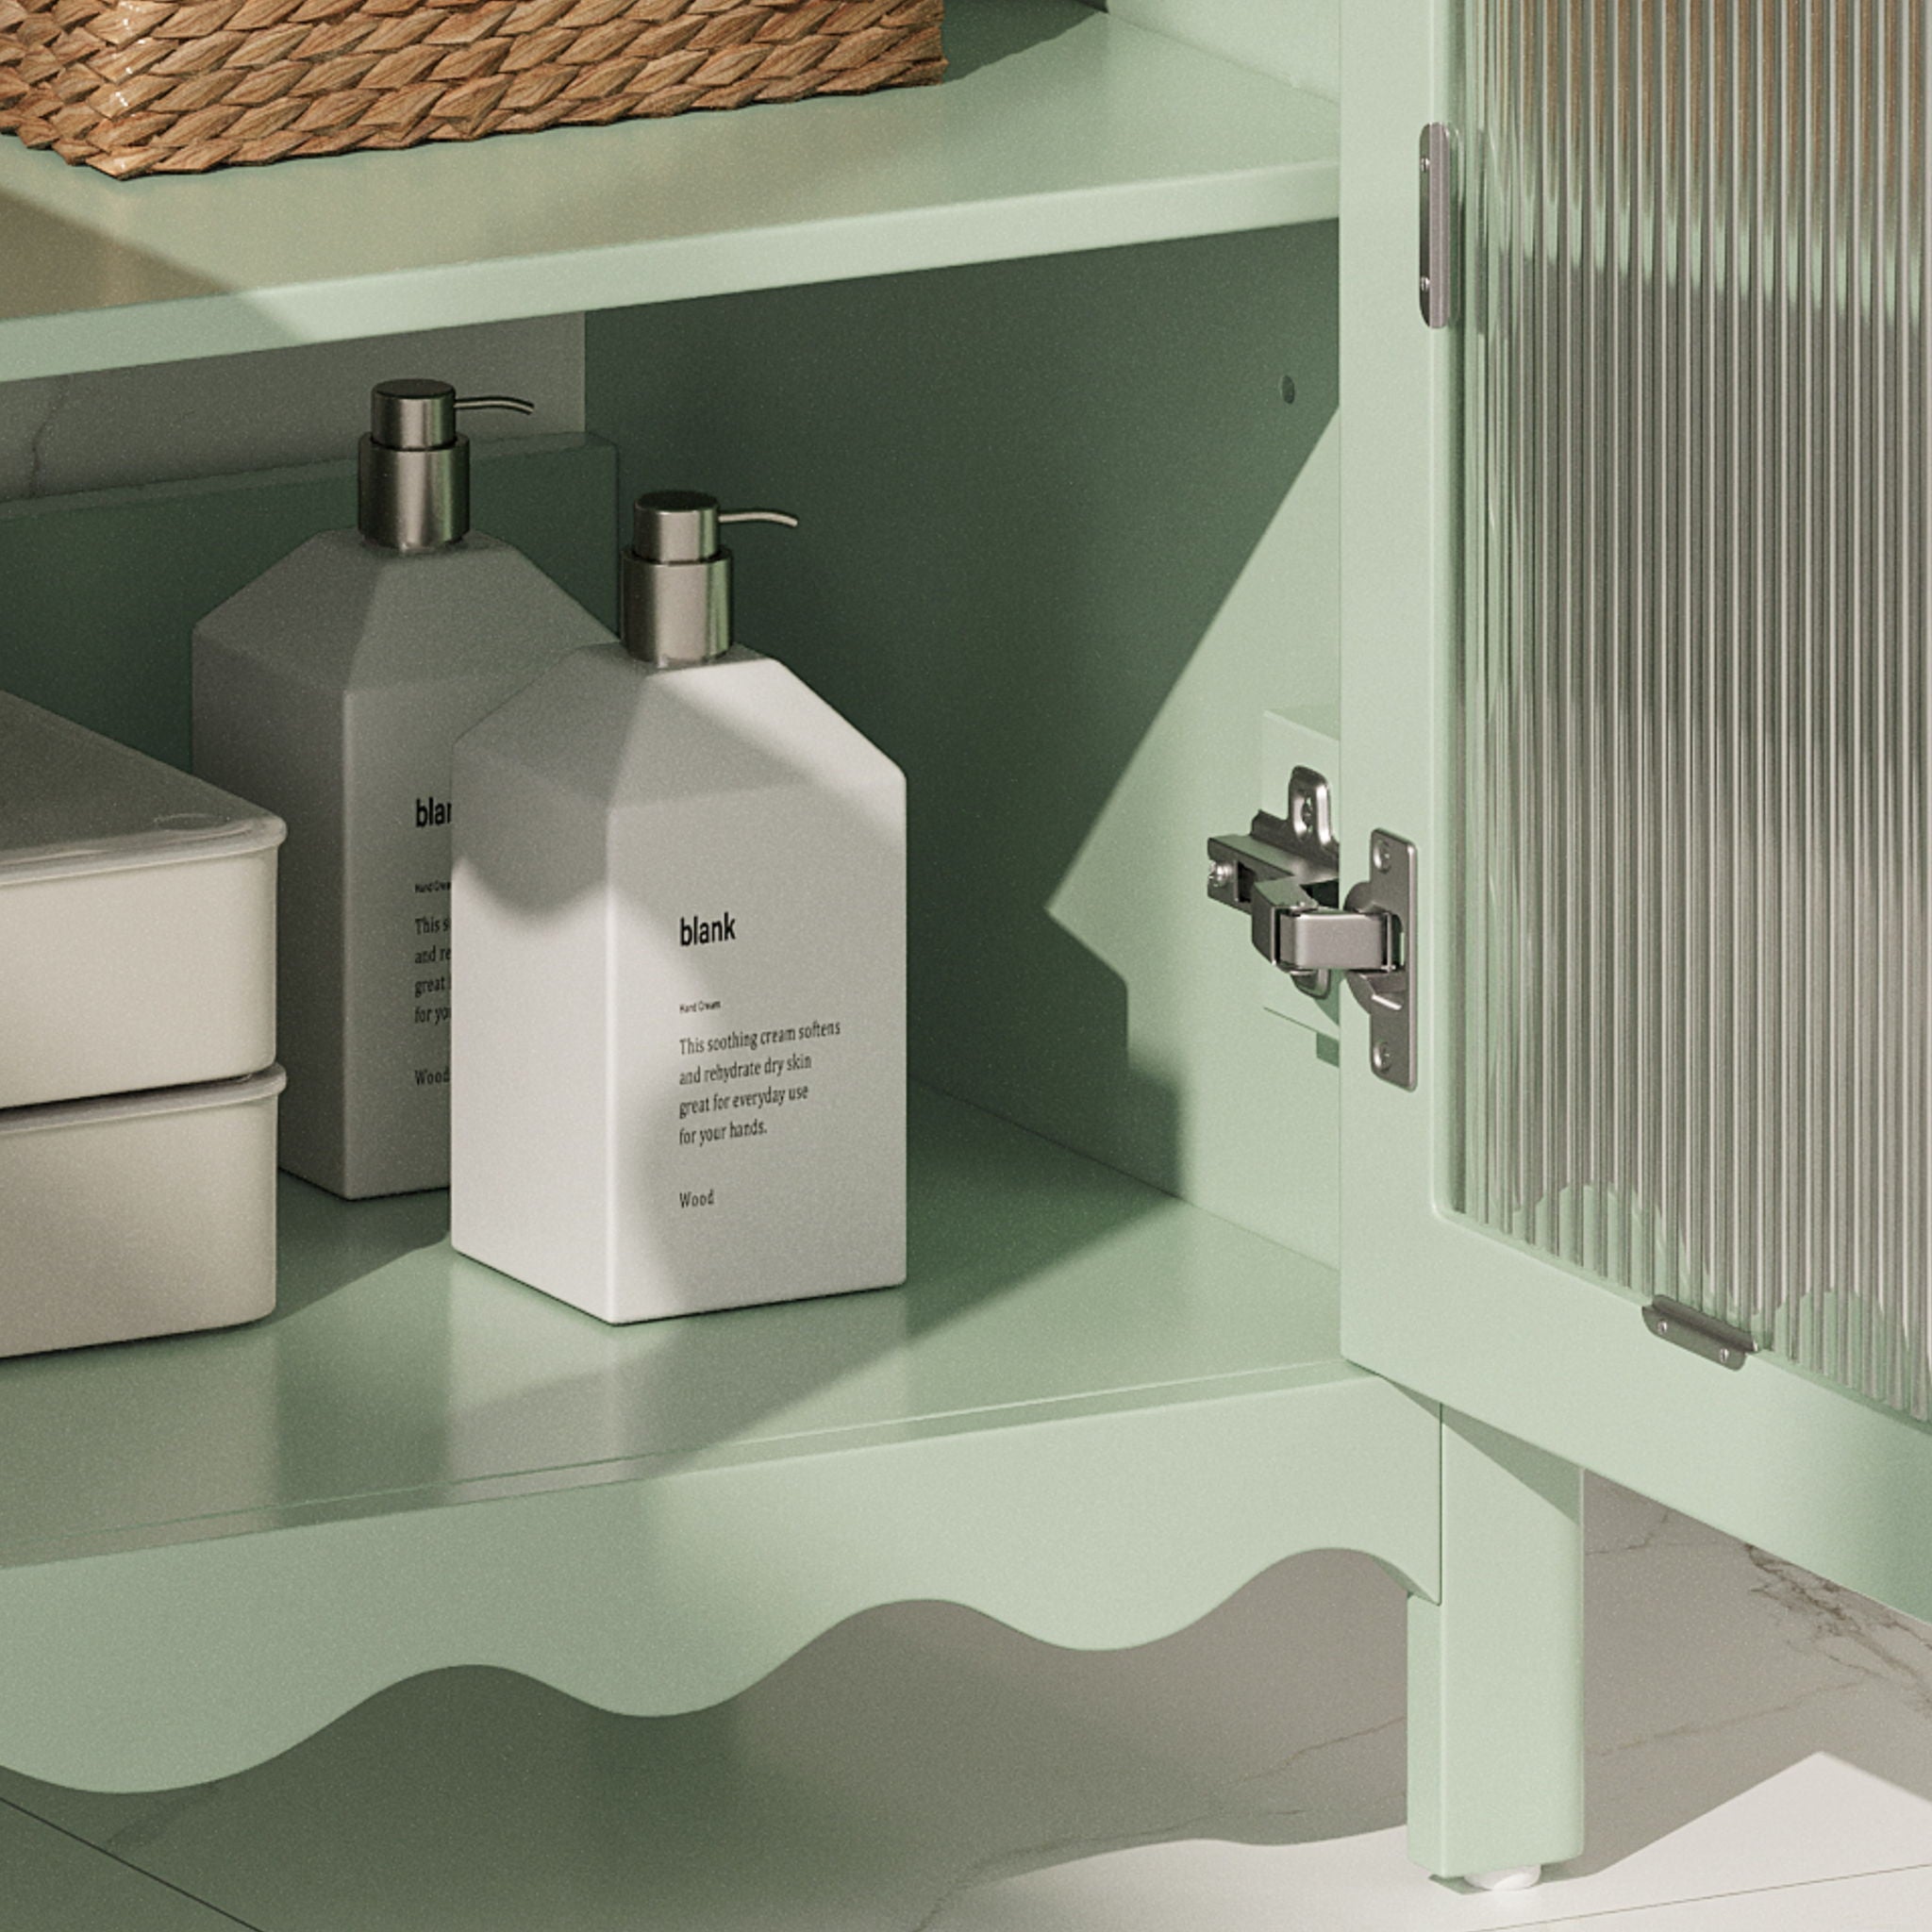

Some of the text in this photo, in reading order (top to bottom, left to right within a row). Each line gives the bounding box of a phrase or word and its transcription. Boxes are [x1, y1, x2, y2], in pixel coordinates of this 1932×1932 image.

[416, 796, 452, 828] bla
[415, 915, 441, 935] This
[680, 911, 736, 946] blank
[415, 944, 436, 963] and
[415, 975, 444, 998] great
[415, 1008, 432, 1024] for
[679, 1020, 841, 1055] This soothing cream softens
[415, 1066, 450, 1086] Wood
[679, 1052, 812, 1085] and rehydrate dry skin
[679, 1086, 808, 1120] great for everyday use
[679, 1118, 768, 1147] for your hands.
[679, 1189, 715, 1208] Wood
